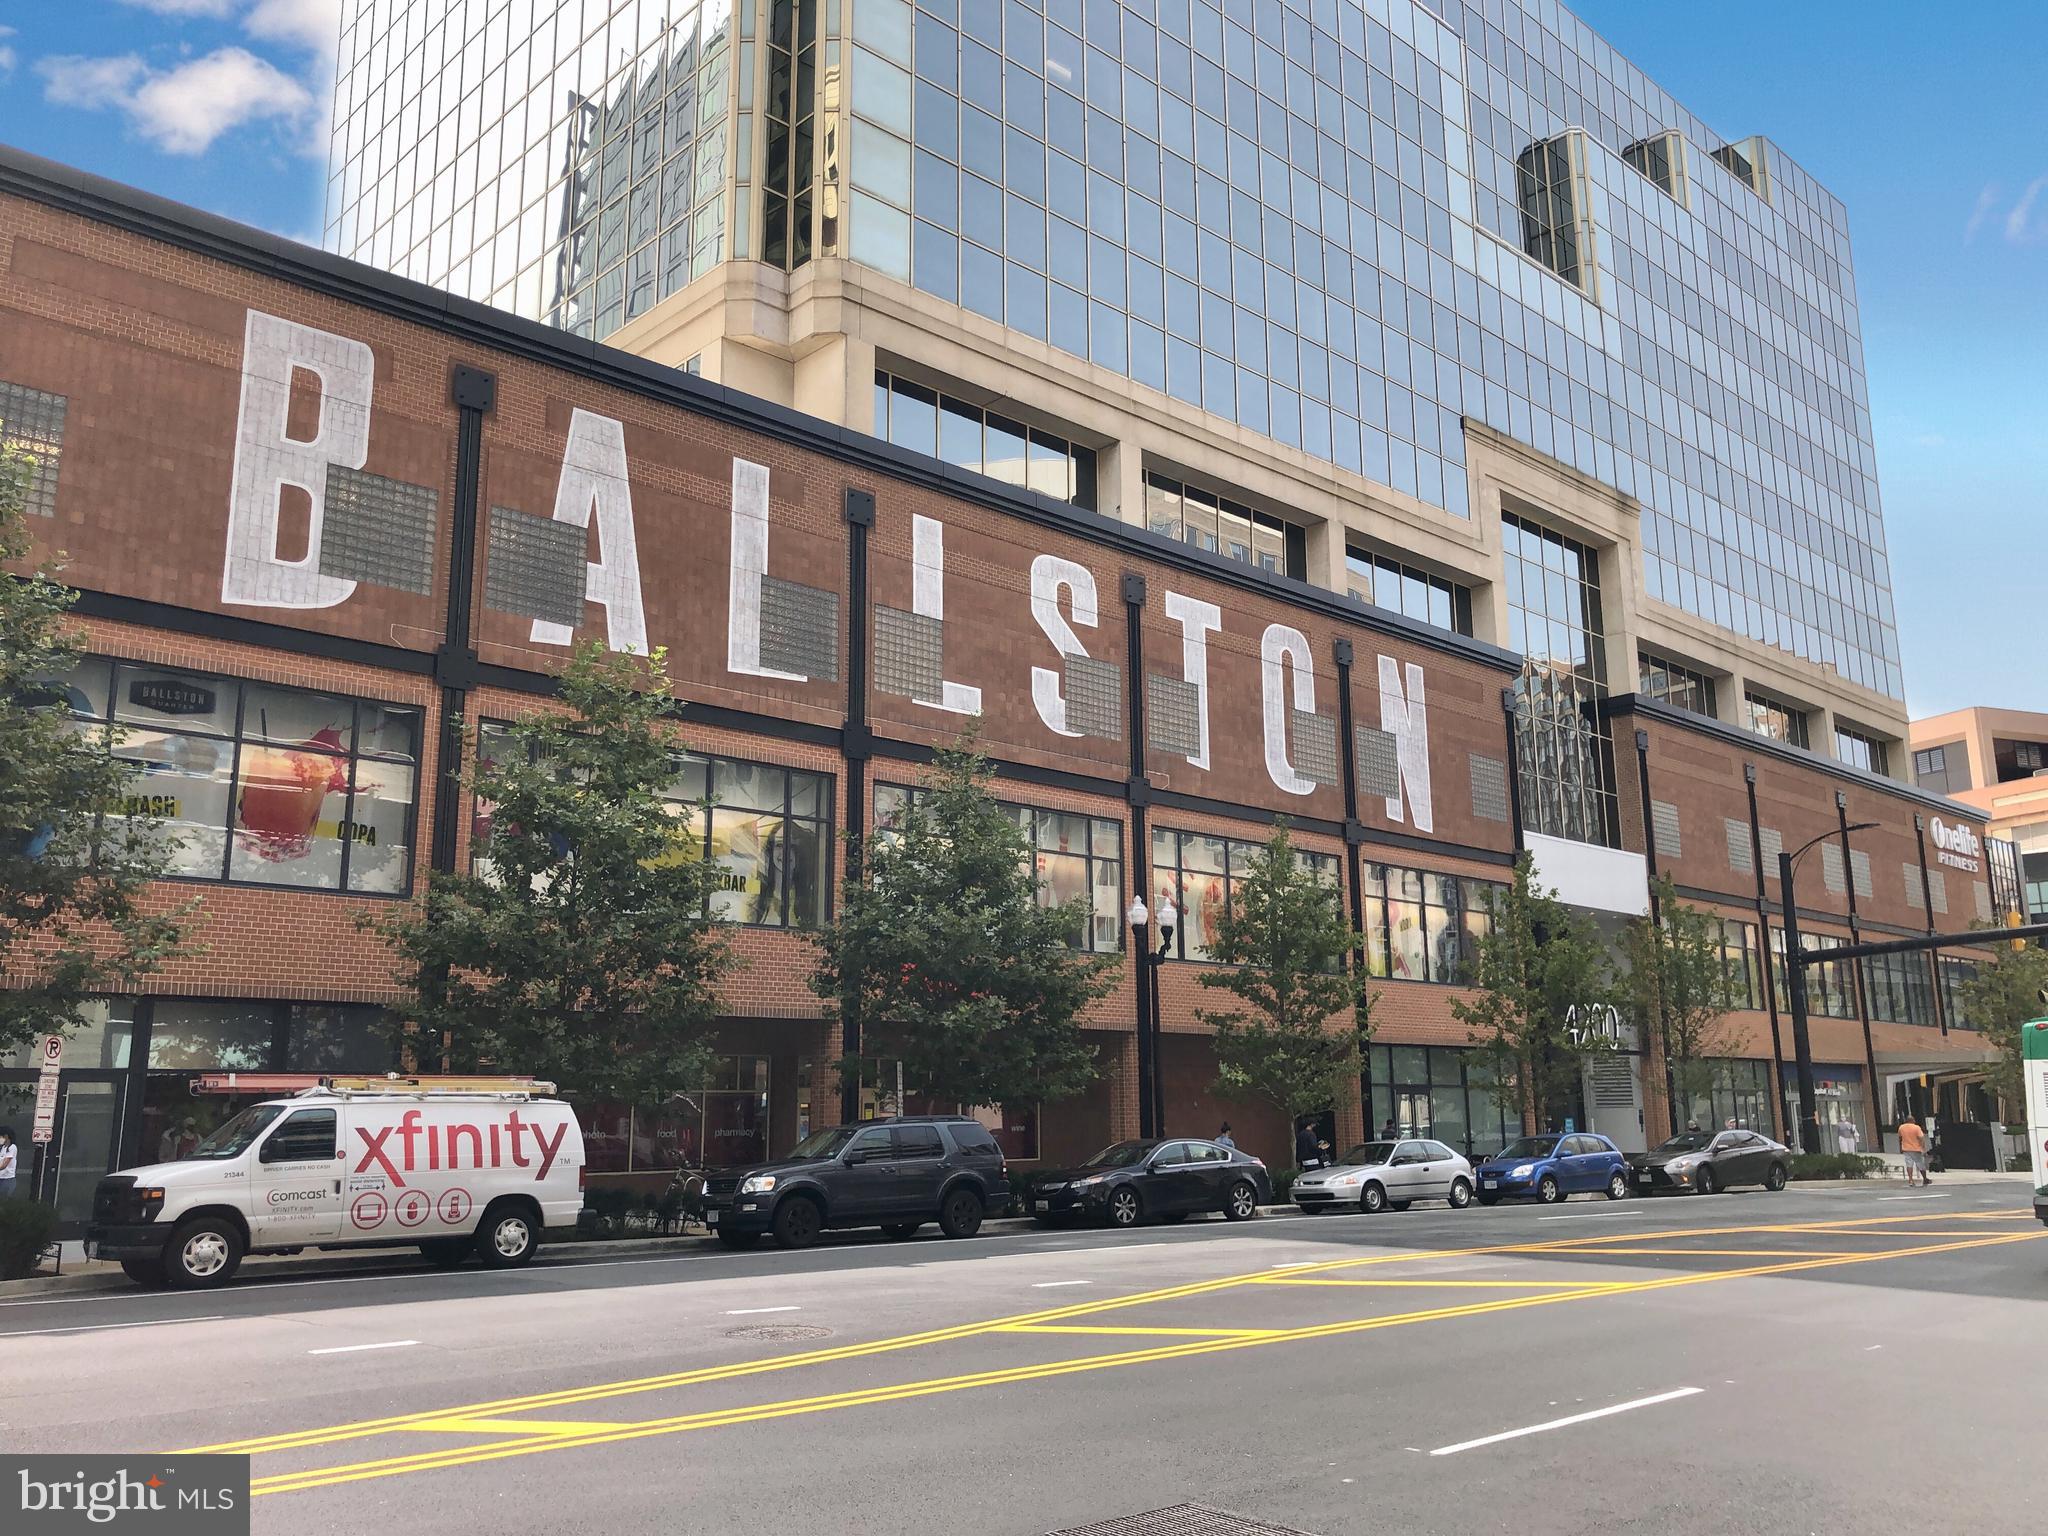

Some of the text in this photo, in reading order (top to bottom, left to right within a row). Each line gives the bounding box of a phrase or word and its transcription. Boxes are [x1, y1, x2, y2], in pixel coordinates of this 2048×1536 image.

[220, 308, 1434, 834] BALLSTON
[142, 686, 206, 705] BALLSTON
[1929, 816, 1979, 858] Onelife
[1937, 851, 1979, 873] FITNESS
[656, 1128, 678, 1139] food
[354, 1109, 569, 1188] xfinity
[224, 1171, 245, 1179] 21344
[266, 1188, 327, 1206] comcast
